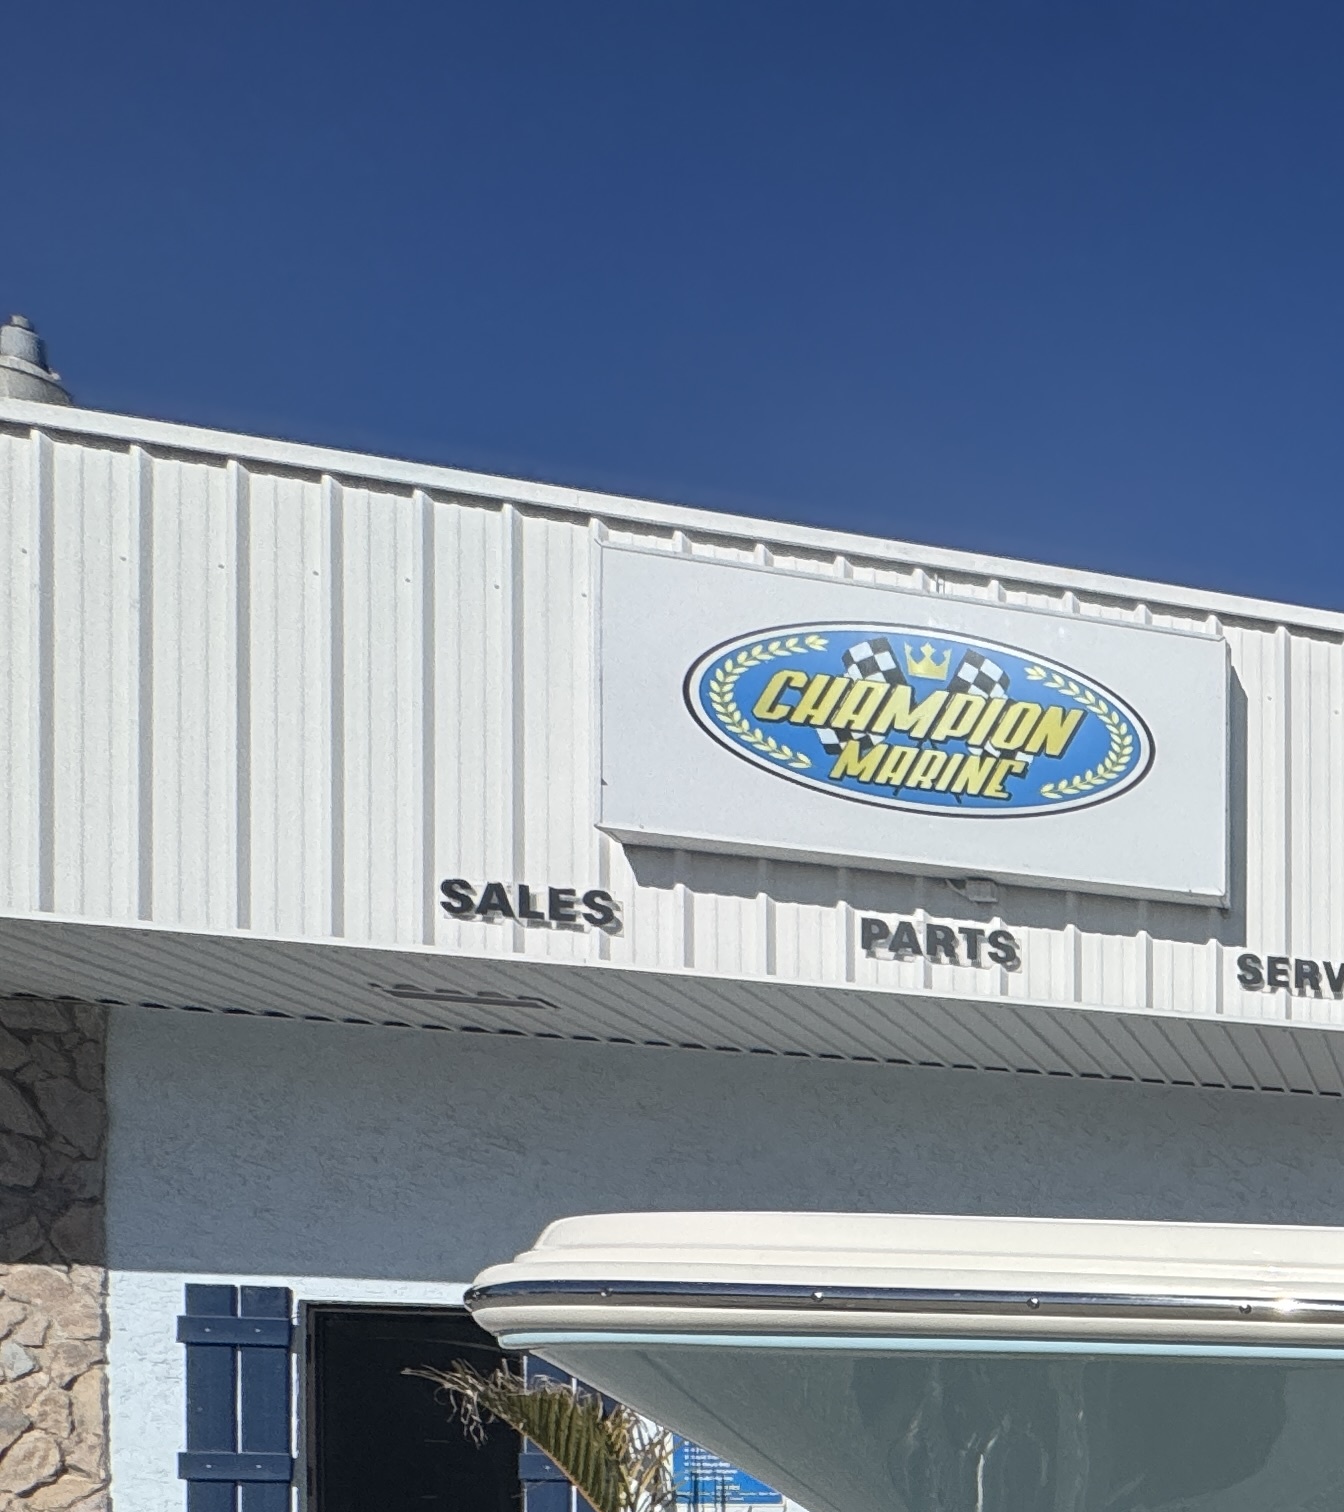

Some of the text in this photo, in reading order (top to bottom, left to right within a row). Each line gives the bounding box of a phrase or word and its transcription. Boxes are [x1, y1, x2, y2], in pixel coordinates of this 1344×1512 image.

[753, 669, 1085, 758] CHAMPION
[830, 739, 1029, 799] MARINE
[440, 879, 617, 927] SALES
[861, 917, 1018, 963] PARTS
